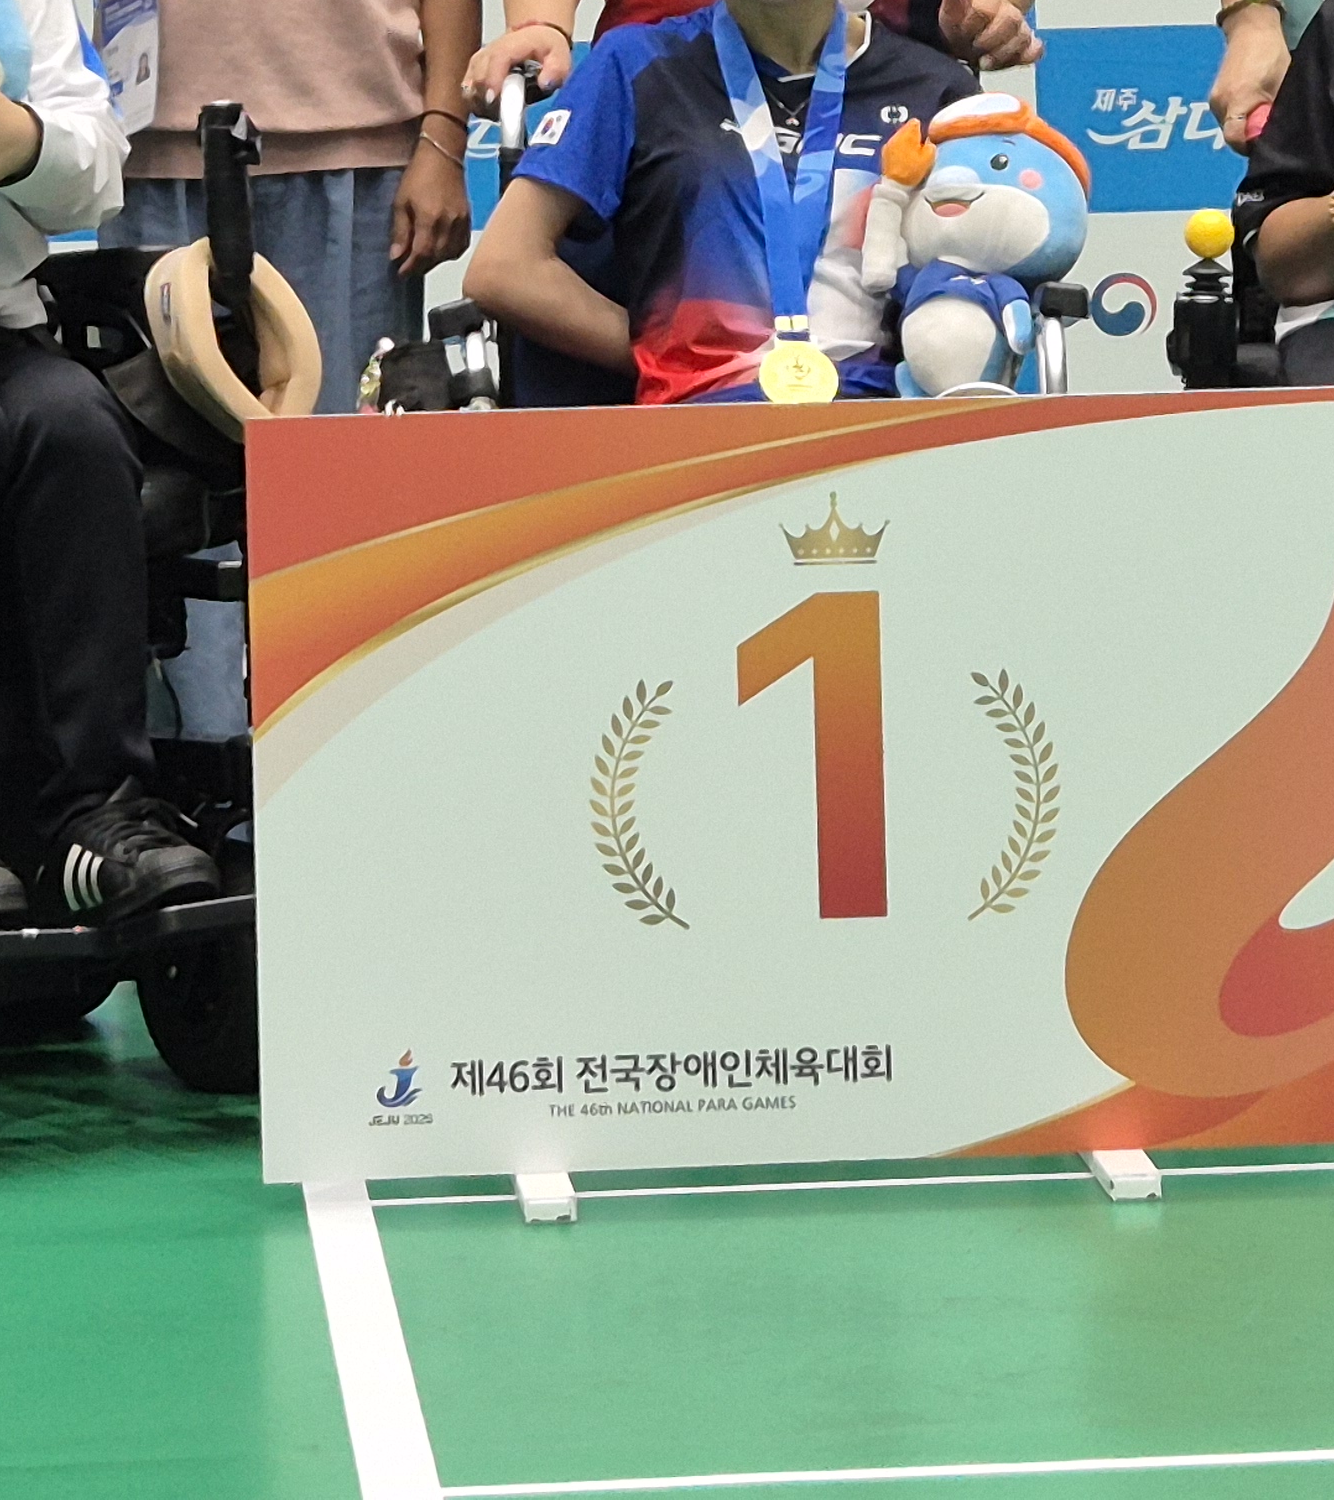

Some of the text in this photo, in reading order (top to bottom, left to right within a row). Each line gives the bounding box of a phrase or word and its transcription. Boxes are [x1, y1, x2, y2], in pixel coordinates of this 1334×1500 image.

[1091, 88, 1139, 112] 제주
[736, 590, 889, 920] 1
[450, 1044, 893, 1097] 제46회 전국장애인체육대회
[549, 1095, 797, 1118] THE 46th NATIONAL PARA GAMES
